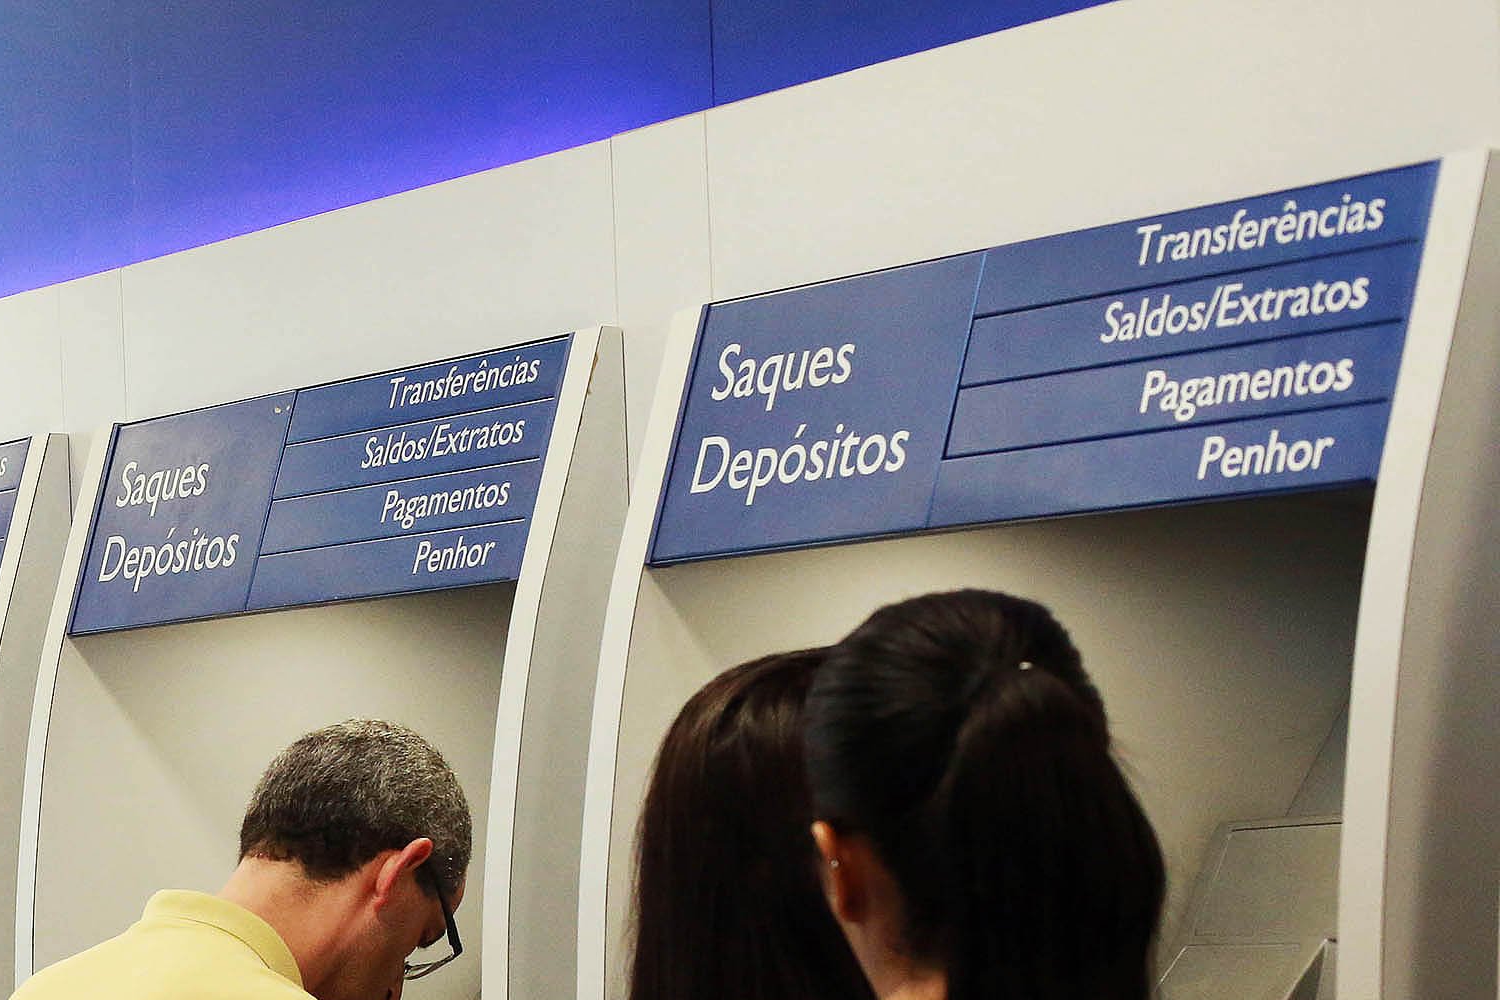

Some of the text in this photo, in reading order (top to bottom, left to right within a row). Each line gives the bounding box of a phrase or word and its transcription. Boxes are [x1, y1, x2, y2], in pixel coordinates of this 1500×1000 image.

[1136, 193, 1385, 266] Transferências
[1099, 277, 1370, 344] Saldos/Extratos
[388, 357, 541, 410] Transferências
[711, 343, 856, 412] Saques
[1139, 358, 1354, 422] Pagamentos
[360, 417, 525, 470] Saldos/Extratos
[689, 423, 910, 506] Depósitos
[1197, 429, 1335, 480] Penhor
[115, 461, 210, 517] Saques
[379, 480, 510, 529] Pagamentos
[98, 527, 240, 593] Depósitos
[412, 537, 496, 574] Penhor
